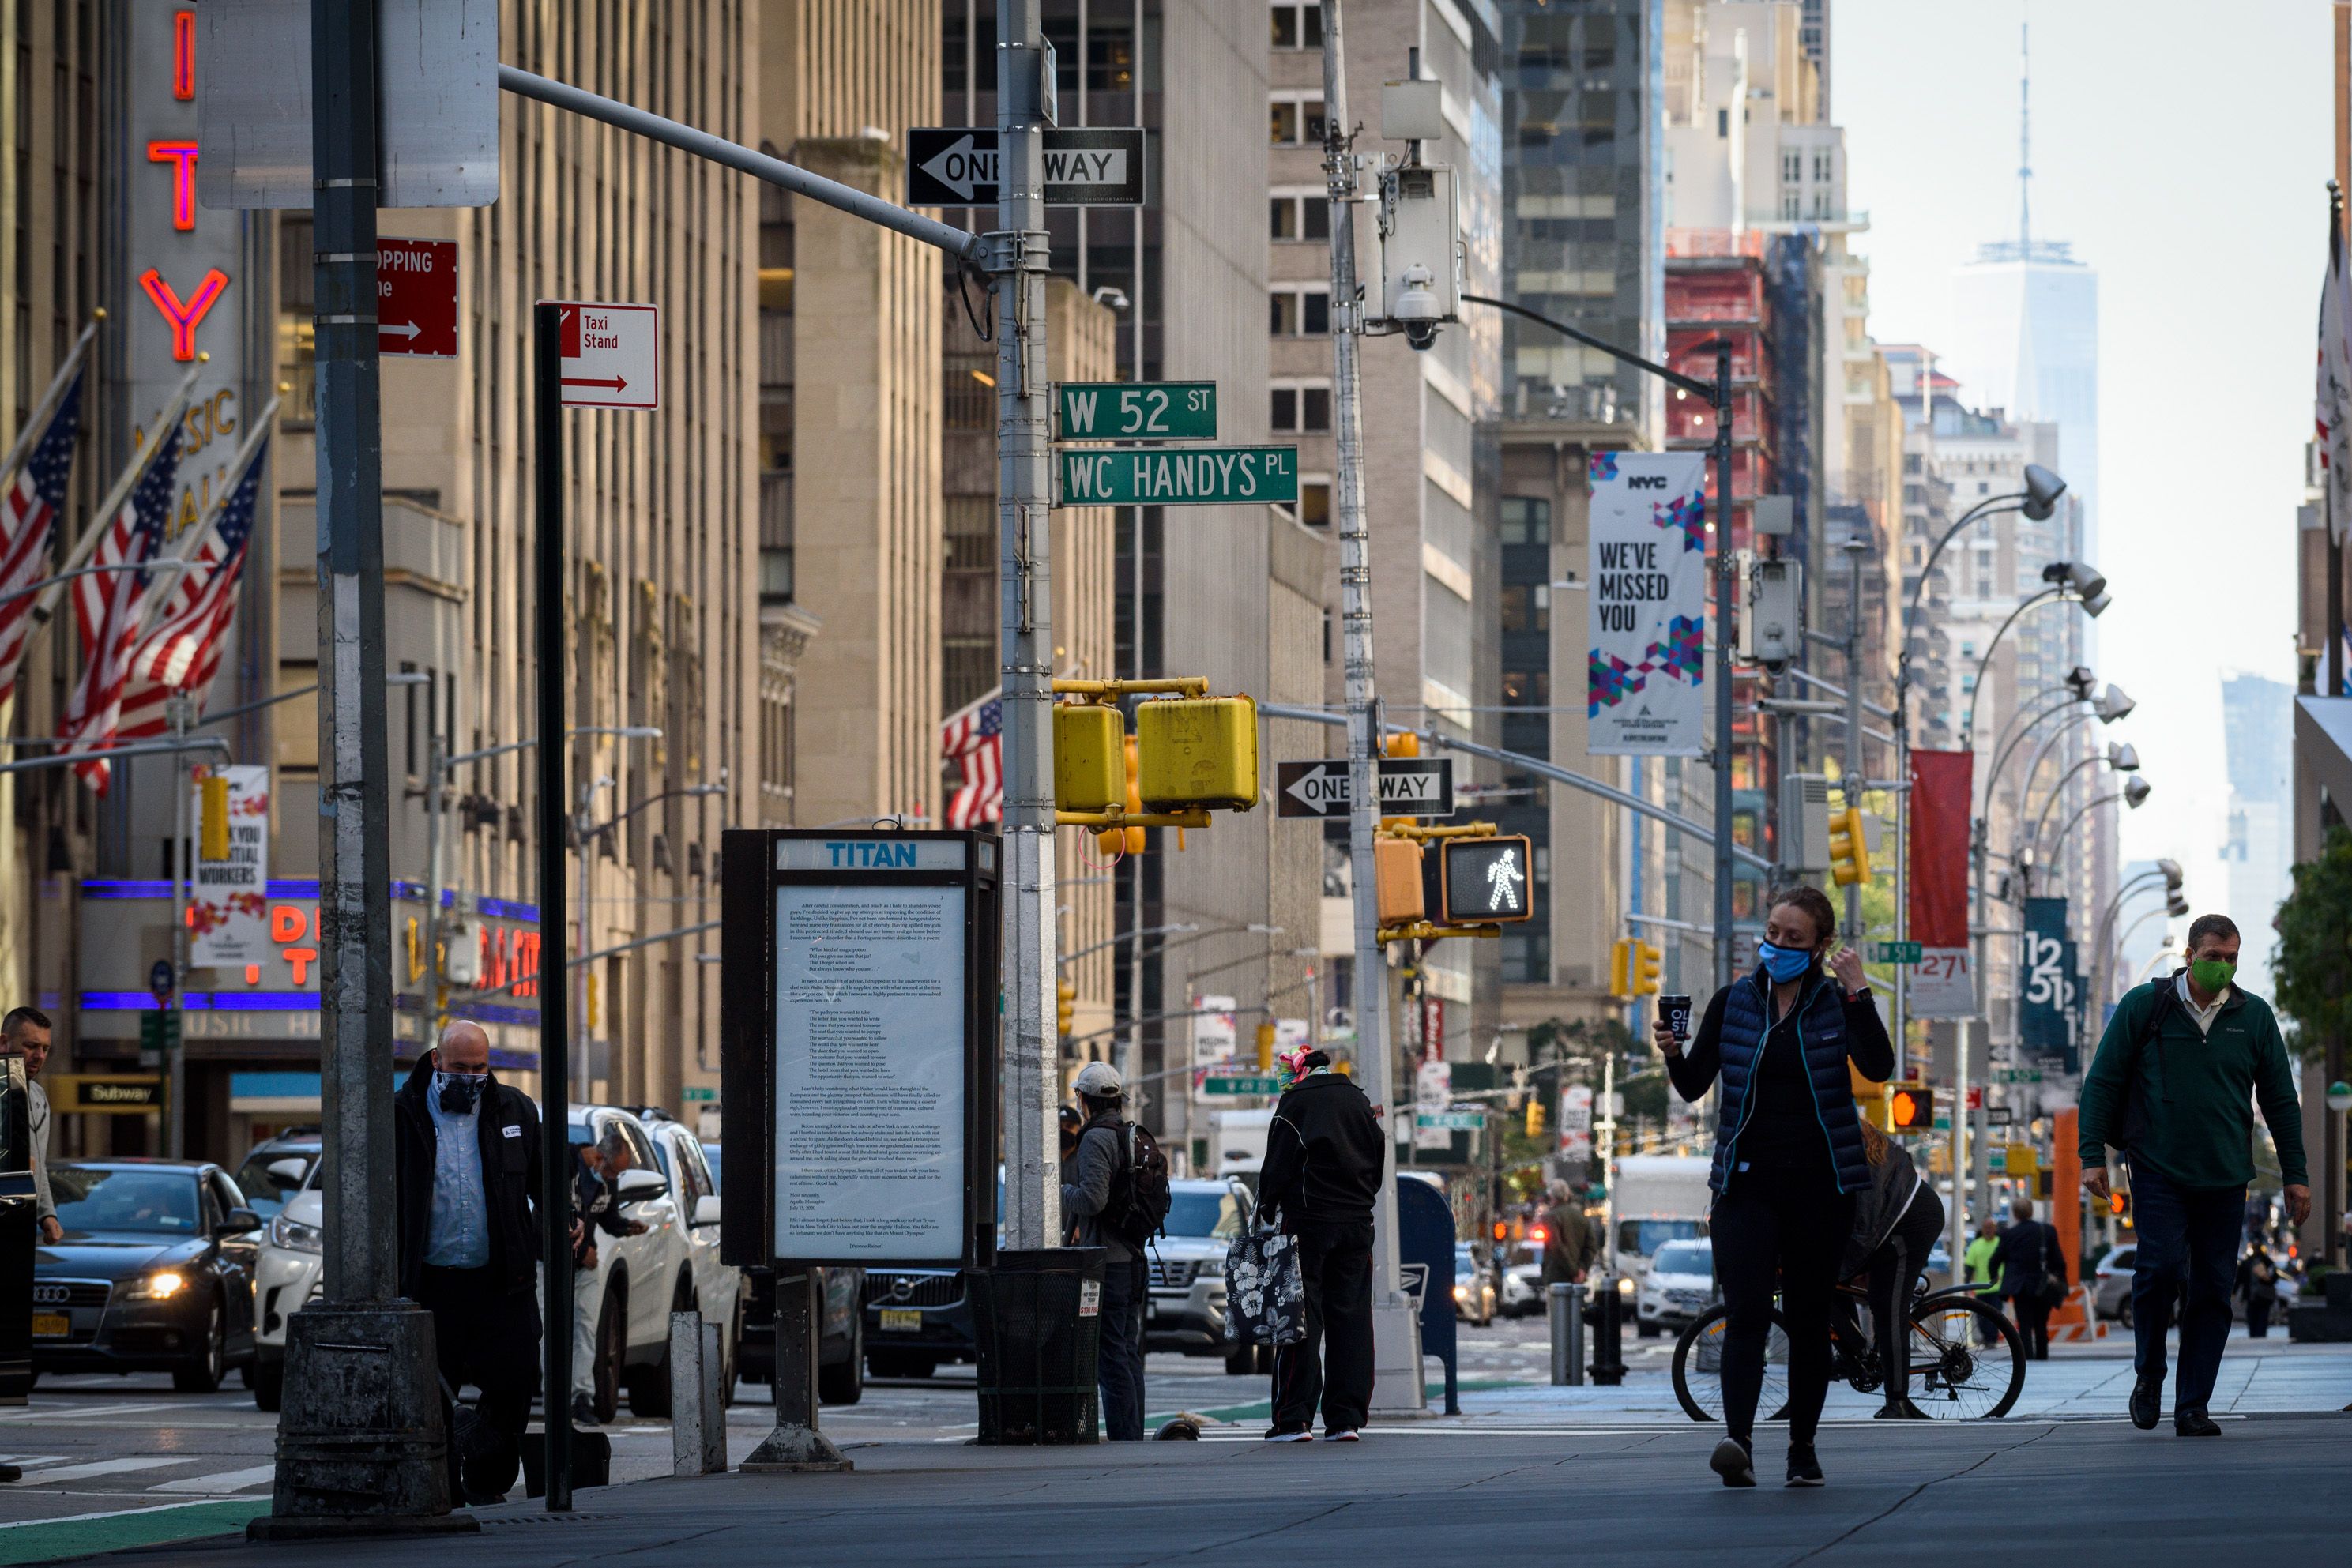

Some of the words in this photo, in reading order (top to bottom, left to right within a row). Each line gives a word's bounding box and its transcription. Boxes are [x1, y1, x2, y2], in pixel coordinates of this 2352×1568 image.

[1043, 152, 1113, 181] WAY
[377, 250, 433, 273] PPING
[585, 315, 608, 330] Taxi
[585, 333, 618, 349] Stand
[1067, 392, 1097, 431] W
[1121, 390, 1169, 432] 52
[1187, 389, 1210, 411] ST
[1070, 456, 1112, 498] WC
[1135, 453, 1255, 497] HANDY'S
[1266, 454, 1289, 476] PL
[1628, 477, 1667, 490] NYC
[1599, 541, 1657, 570] WE'VE
[1599, 573, 1669, 601] MISSED
[1600, 604, 1635, 632] YOU
[1305, 779, 1350, 799] ONE
[1379, 776, 1429, 798] WAY
[826, 843, 916, 867] TITAN
[199, 866, 257, 886] WORKERS
[1881, 945, 1889, 960] W
[1895, 946, 1906, 961] 51
[2025, 931, 2062, 973] 12
[2027, 968, 2063, 1011] 51
[90, 1083, 151, 1103] Subway
